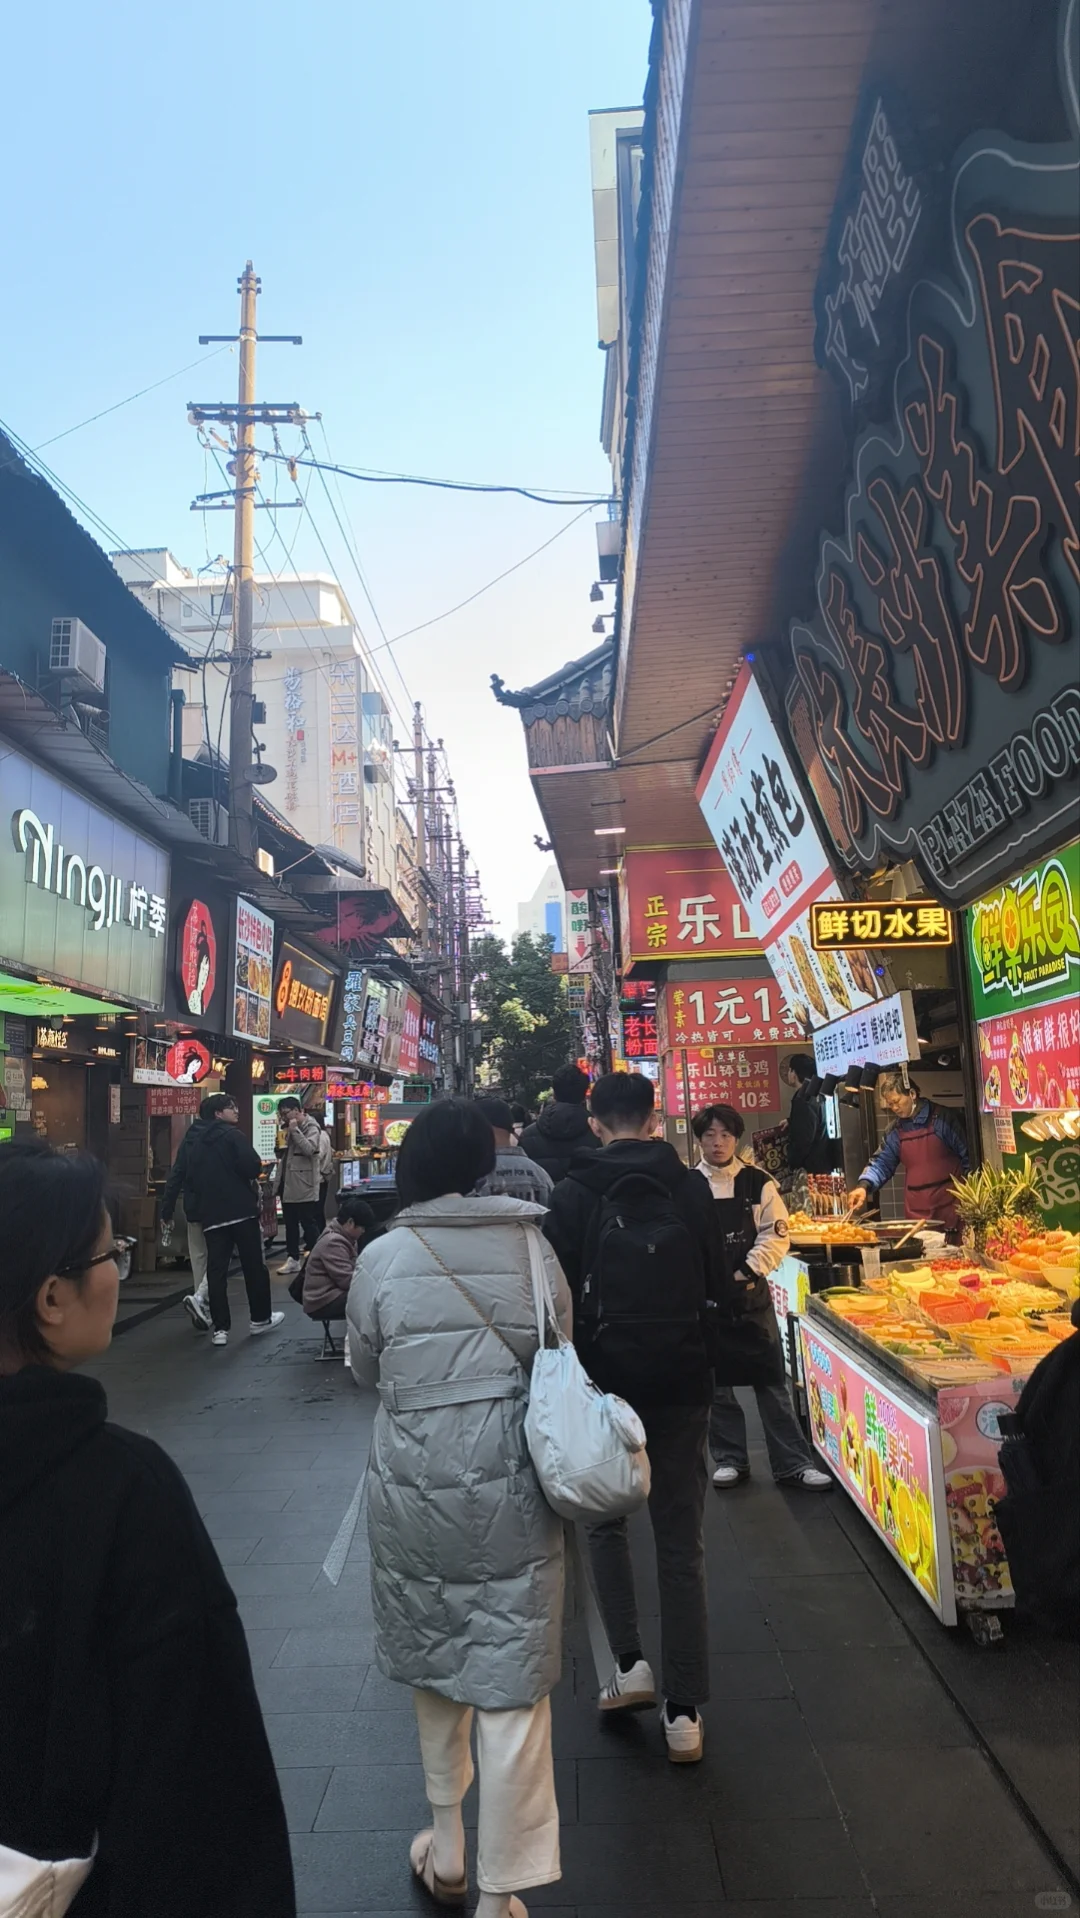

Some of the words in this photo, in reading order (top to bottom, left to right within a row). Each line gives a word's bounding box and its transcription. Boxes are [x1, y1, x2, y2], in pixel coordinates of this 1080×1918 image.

[721, 752, 805, 904] 灌汤生煎包
[918, 760, 992, 874] PLAZA
[129, 880, 167, 938] 柠季
[644, 895, 669, 949] 正宗
[817, 908, 948, 941] 鲜切水果
[237, 906, 273, 955] 长沙特色小吃
[1023, 968, 1038, 983] FRUIT
[1038, 957, 1066, 978] PARADISE
[673, 988, 687, 1028] 荤素
[870, 1008, 902, 1047] 糖油粑粑
[286, 1067, 324, 1082] 牛肉粉
[739, 1091, 771, 1108] 10签
[879, 1397, 898, 1433] 100%
